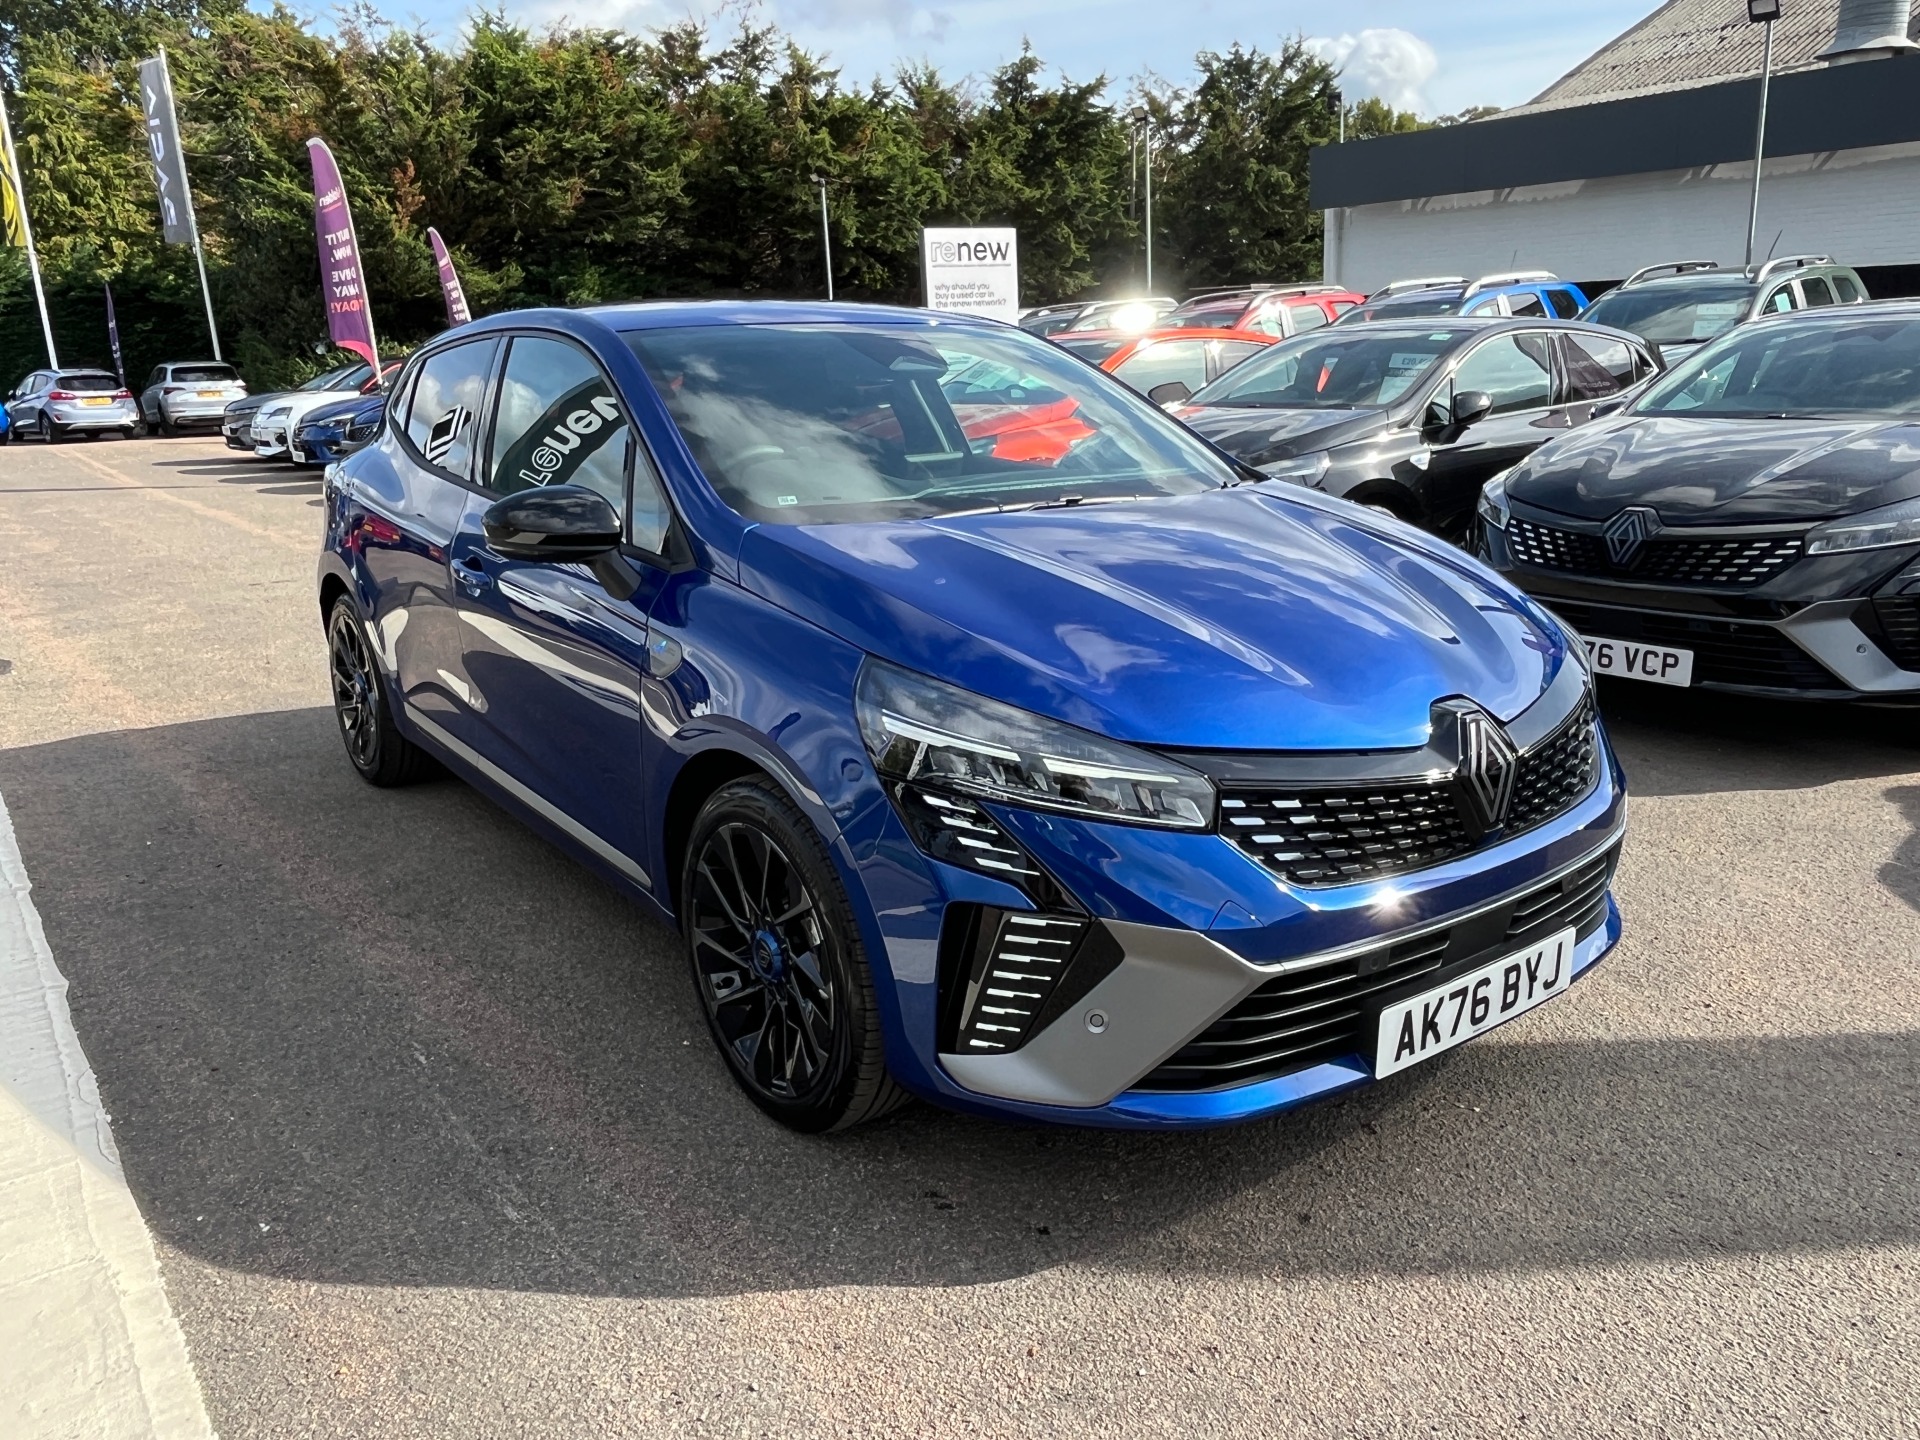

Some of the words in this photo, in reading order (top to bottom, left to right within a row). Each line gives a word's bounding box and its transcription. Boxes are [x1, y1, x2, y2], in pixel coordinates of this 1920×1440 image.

[931, 242, 1009, 262] renew
[935, 284, 950, 292] why
[935, 292, 949, 300] buy
[973, 299, 1007, 307] network?
[1624, 646, 1680, 677] VCP
[1394, 976, 1491, 1063] AK76
[1500, 941, 1564, 1014] BYJ
